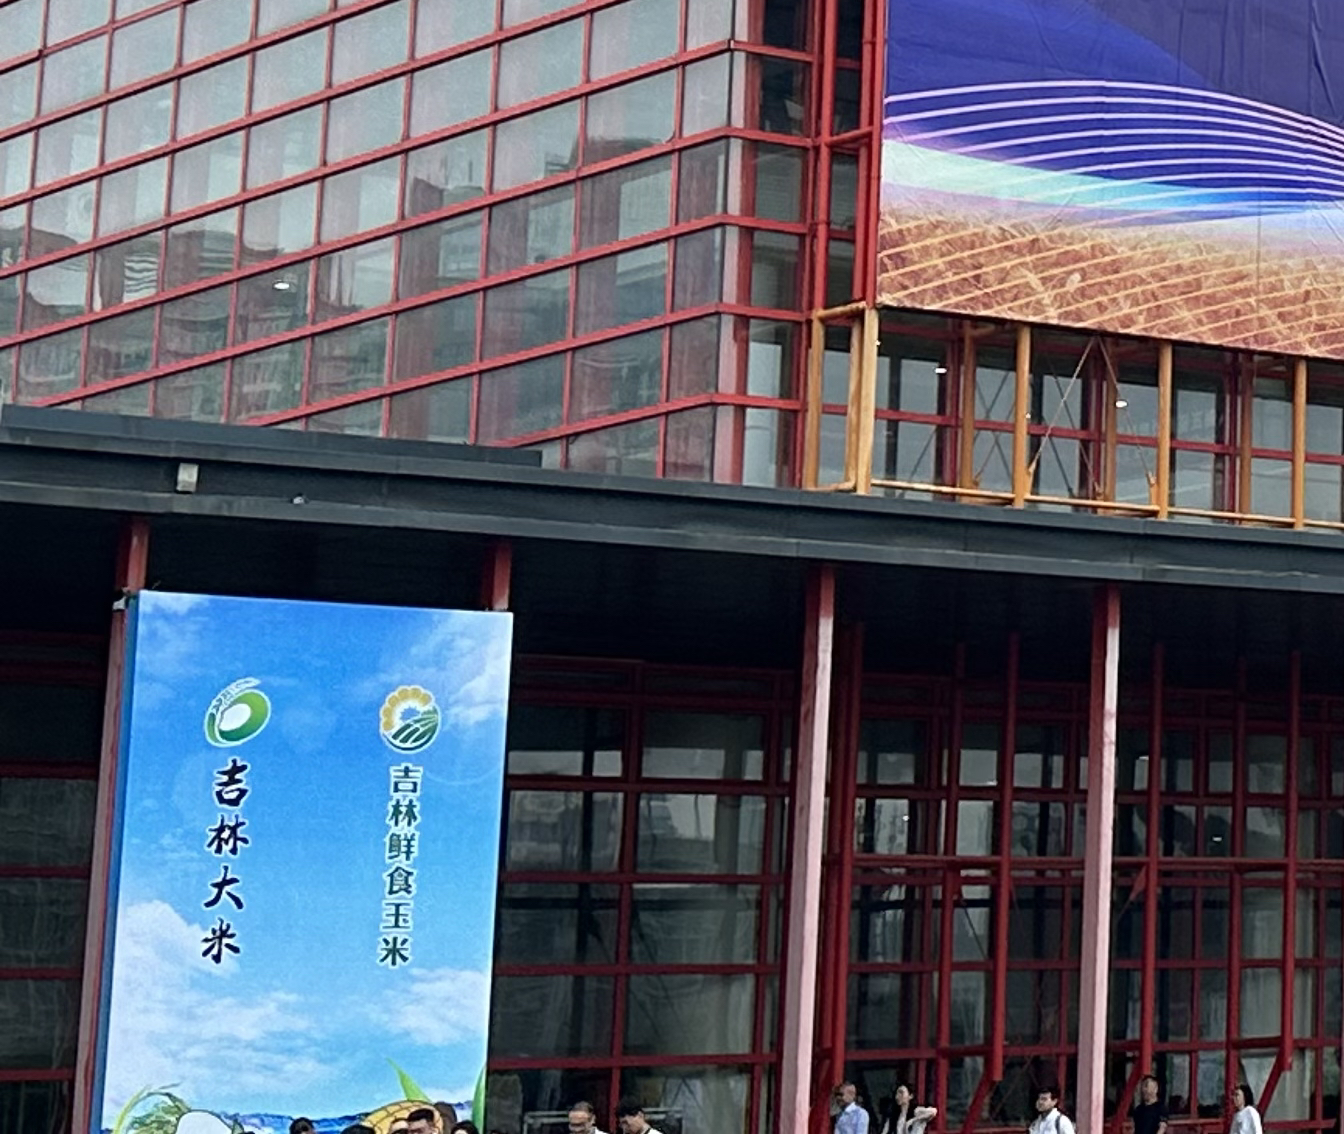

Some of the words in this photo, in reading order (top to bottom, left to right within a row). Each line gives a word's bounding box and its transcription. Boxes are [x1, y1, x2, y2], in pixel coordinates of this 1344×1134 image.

[201, 758, 250, 964] 吉林大米
[378, 763, 423, 968] 吉林鲜食玉米
